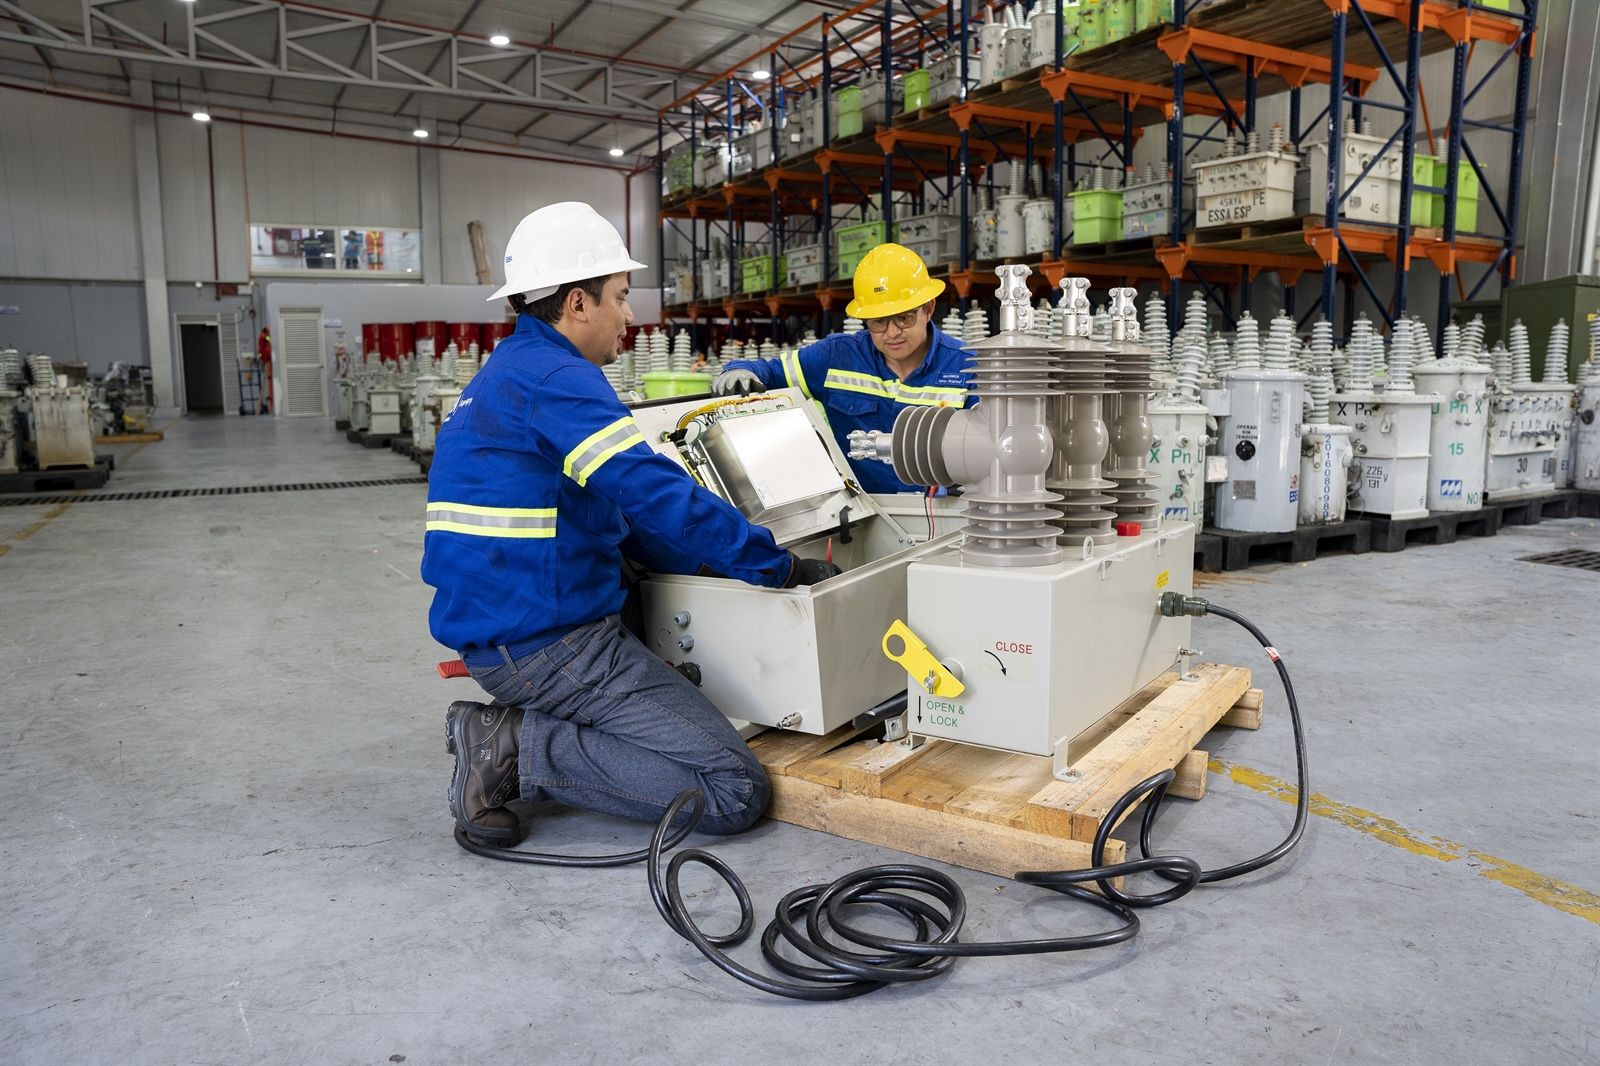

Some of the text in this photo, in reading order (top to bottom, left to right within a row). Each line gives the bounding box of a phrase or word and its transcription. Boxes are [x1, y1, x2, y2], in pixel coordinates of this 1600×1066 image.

[1207, 205, 1252, 223] ESSA ESP
[1337, 403, 1347, 417] X
[1449, 399, 1469, 414] Pn
[1474, 399, 1483, 415] X
[1149, 448, 1204, 464] X Pn U
[1448, 442, 1465, 456] 15
[1366, 465, 1383, 476] 226
[1516, 457, 1529, 474] 30
[1175, 483, 1184, 499] 5
[995, 641, 1033, 655] CLOSE
[926, 700, 966, 716] OPEN &
[930, 714, 959, 728] LOCK
